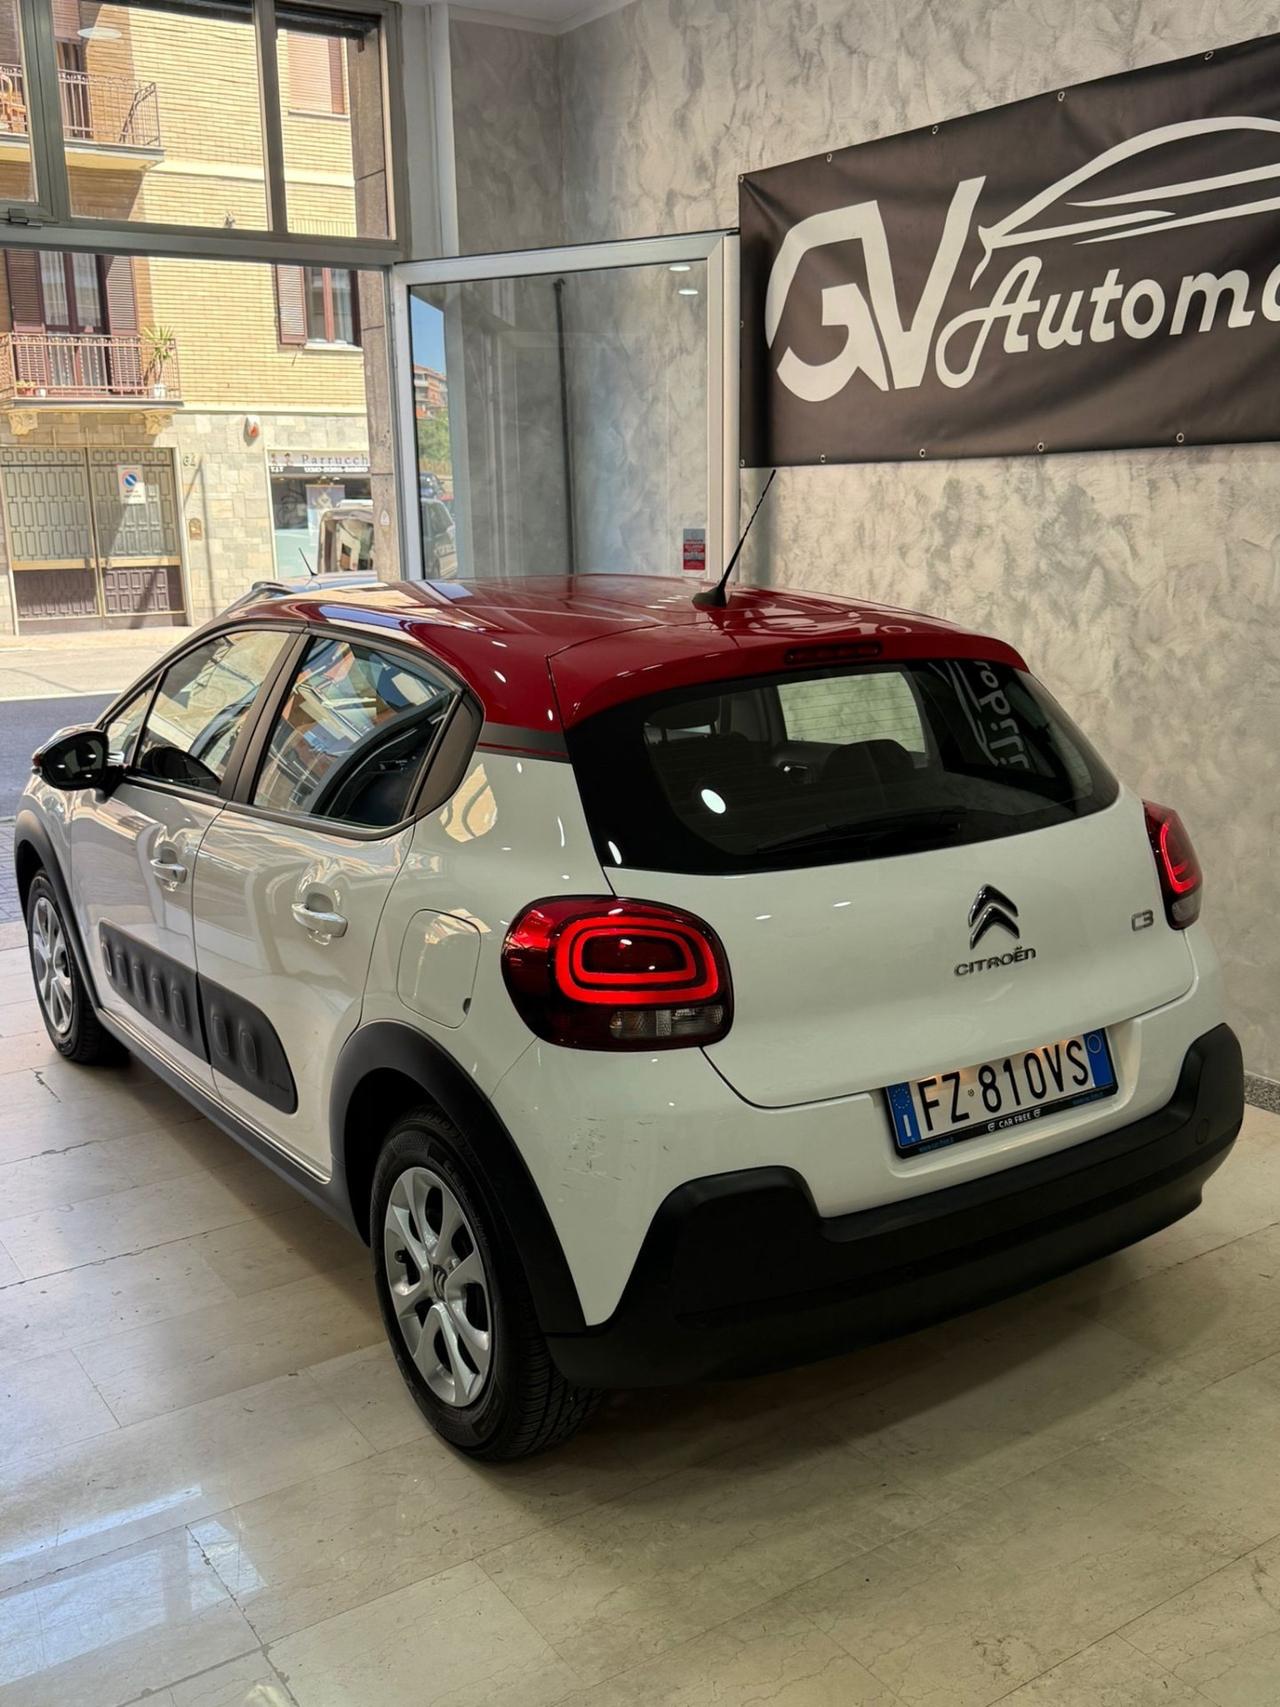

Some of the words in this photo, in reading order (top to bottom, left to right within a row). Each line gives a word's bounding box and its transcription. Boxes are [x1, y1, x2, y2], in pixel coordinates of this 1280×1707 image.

[765, 175, 987, 402] GV
[1131, 909, 1154, 931] C3
[998, 1118, 1014, 1129] CAR
[1014, 1112, 1031, 1125] FREE
